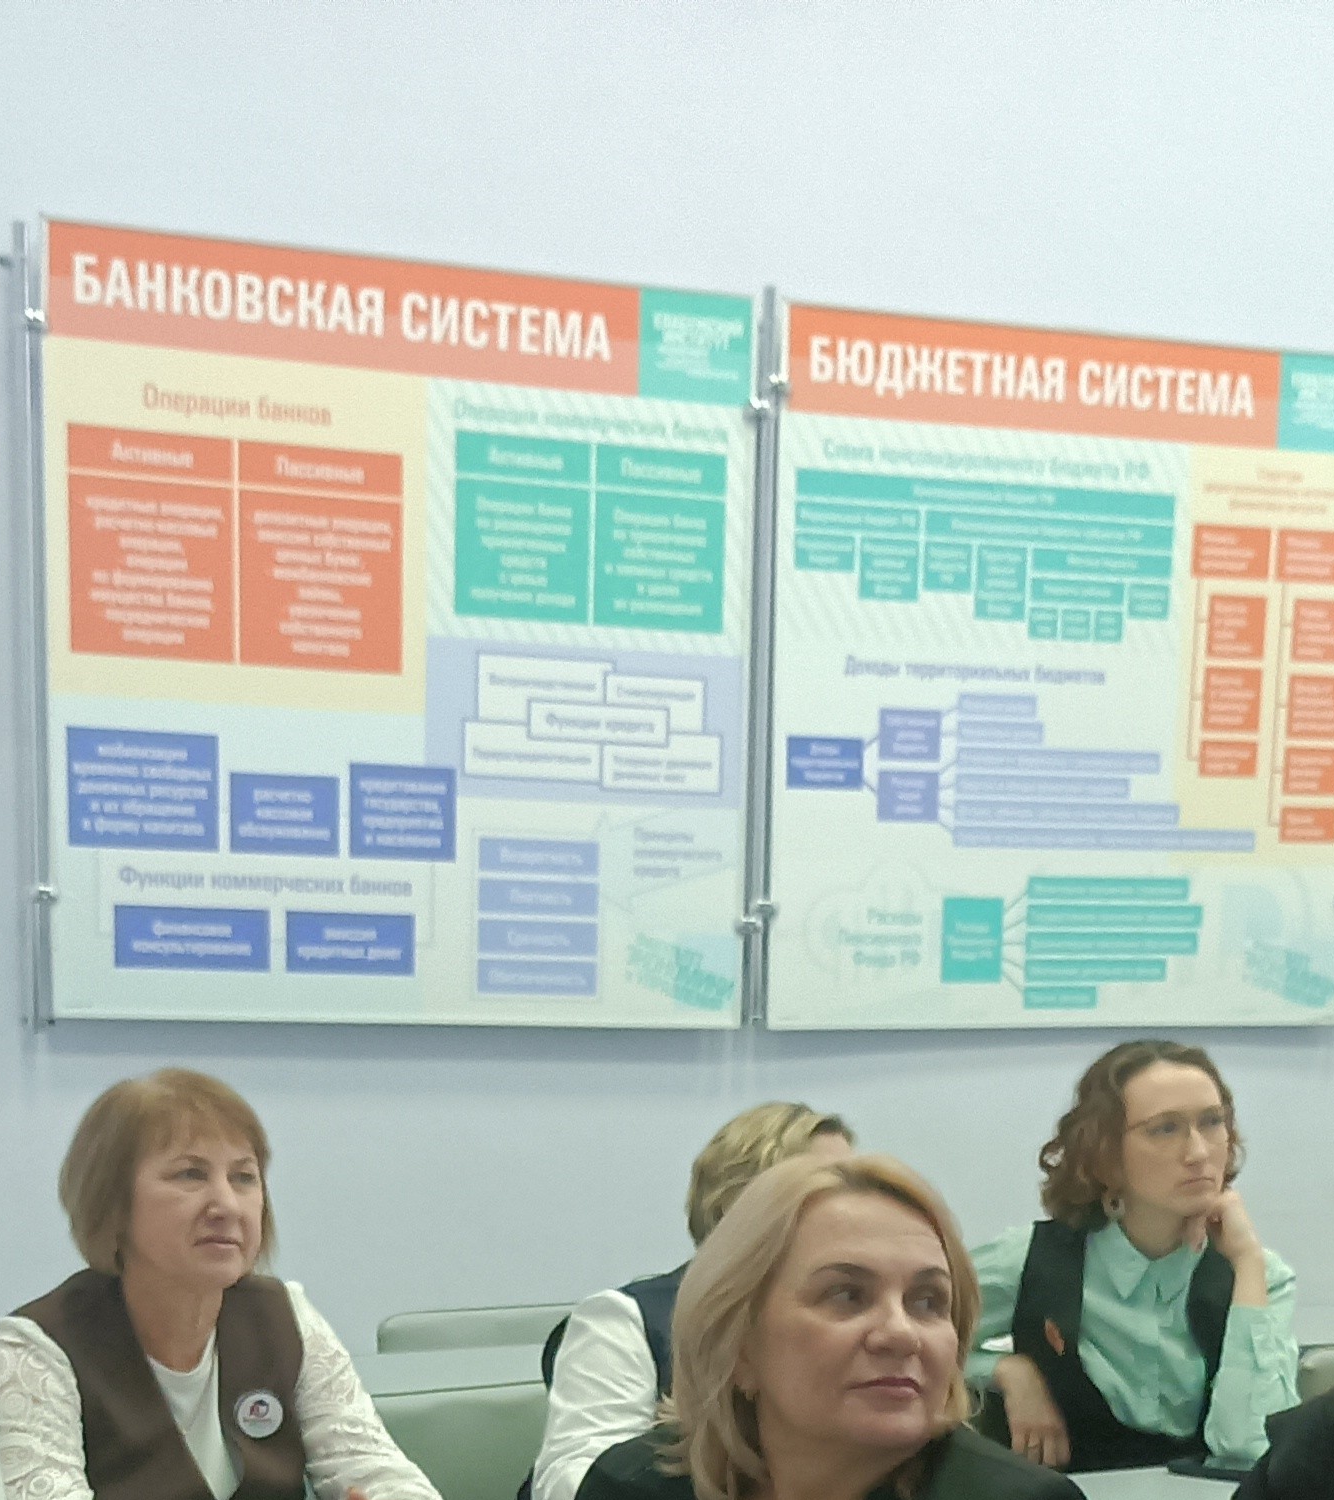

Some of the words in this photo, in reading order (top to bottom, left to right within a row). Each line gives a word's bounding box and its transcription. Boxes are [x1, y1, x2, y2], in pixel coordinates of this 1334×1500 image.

[72, 253, 385, 337] БАНКОВСКАЯ
[402, 292, 612, 363] СИСТЕМА
[143, 382, 251, 420] Операции
[258, 395, 332, 427] банков
[809, 335, 1067, 403] БЮДЖЕТНАЯ
[1078, 360, 1255, 420] СИСТЕМА
[119, 864, 205, 892] Функции
[211, 870, 345, 897] коммерческих
[350, 873, 413, 898] банков
